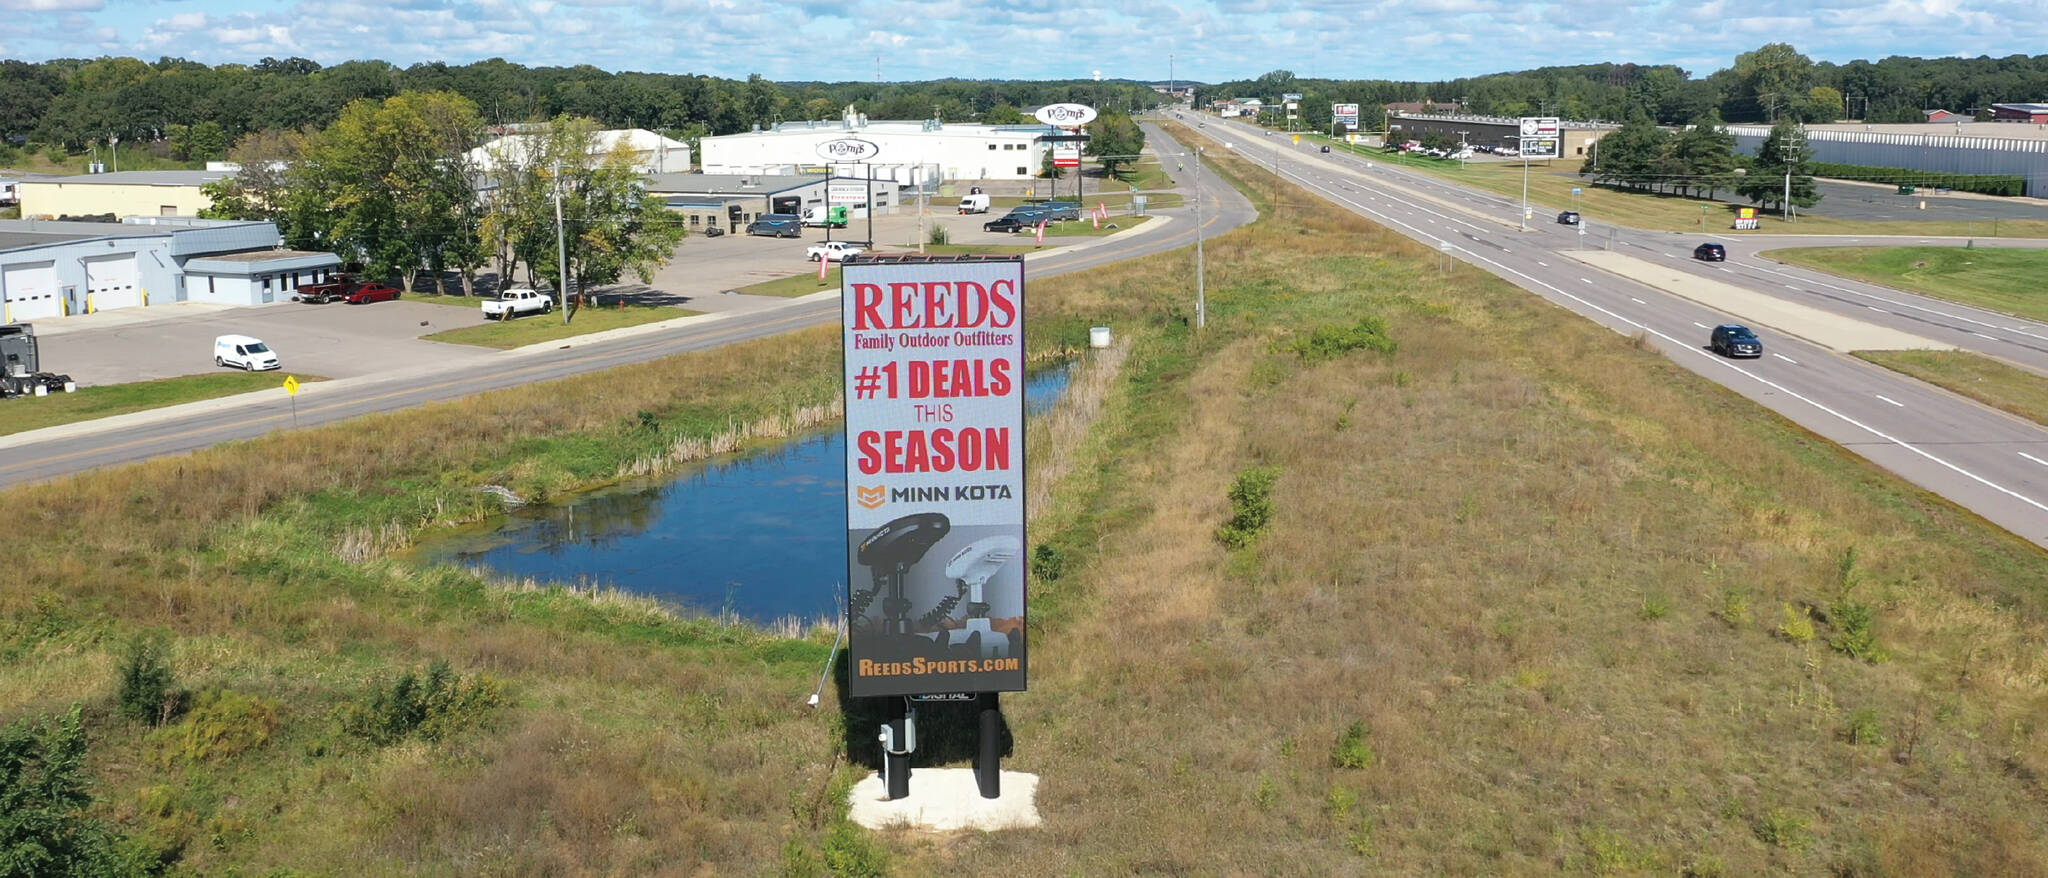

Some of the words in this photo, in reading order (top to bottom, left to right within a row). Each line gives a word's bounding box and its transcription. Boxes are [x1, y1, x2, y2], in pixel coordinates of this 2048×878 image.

[852, 280, 1016, 331] REEDS
[855, 333, 895, 352] Family
[899, 332, 950, 348] Outdoor
[954, 331, 1013, 347] Outfitters
[854, 361, 898, 399] #1
[908, 358, 1011, 399] DEALS
[914, 404, 954, 423] THIS
[857, 427, 1009, 475] SEASON
[891, 487, 949, 503] MINN
[955, 484, 1012, 501] KOTA
